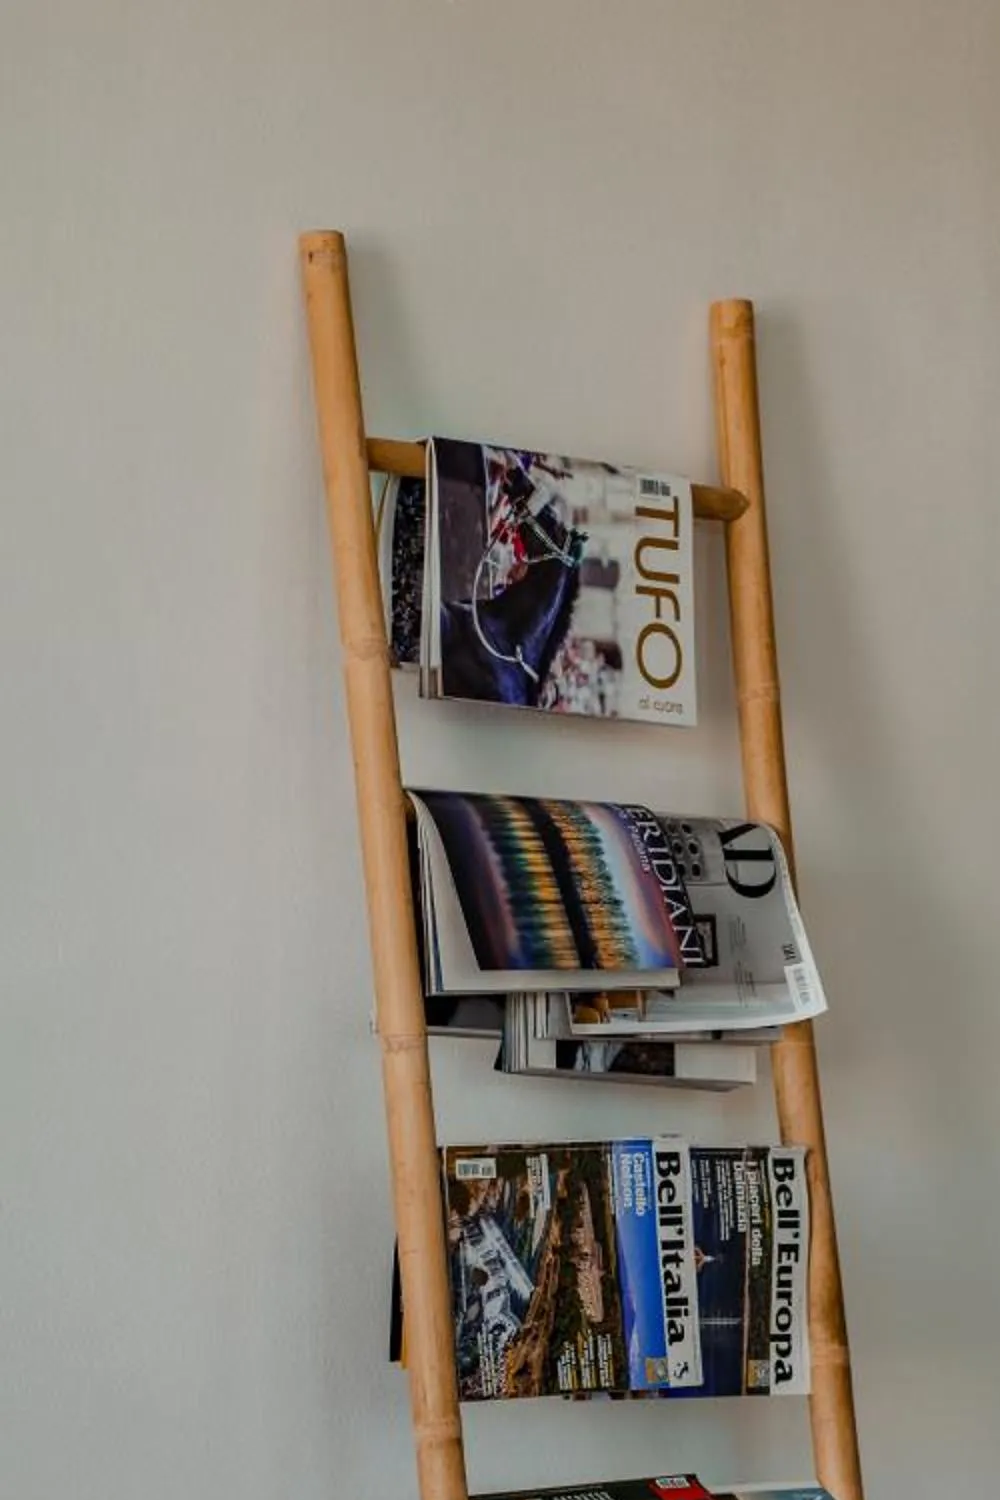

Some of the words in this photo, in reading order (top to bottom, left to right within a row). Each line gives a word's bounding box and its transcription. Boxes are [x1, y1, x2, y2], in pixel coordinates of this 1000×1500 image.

[634, 496, 682, 689] TUFO
[627, 806, 705, 965] ERIDIANI
[655, 1151, 689, 1346] Bell'Italia
[770, 1158, 800, 1385] Bell'Europa
